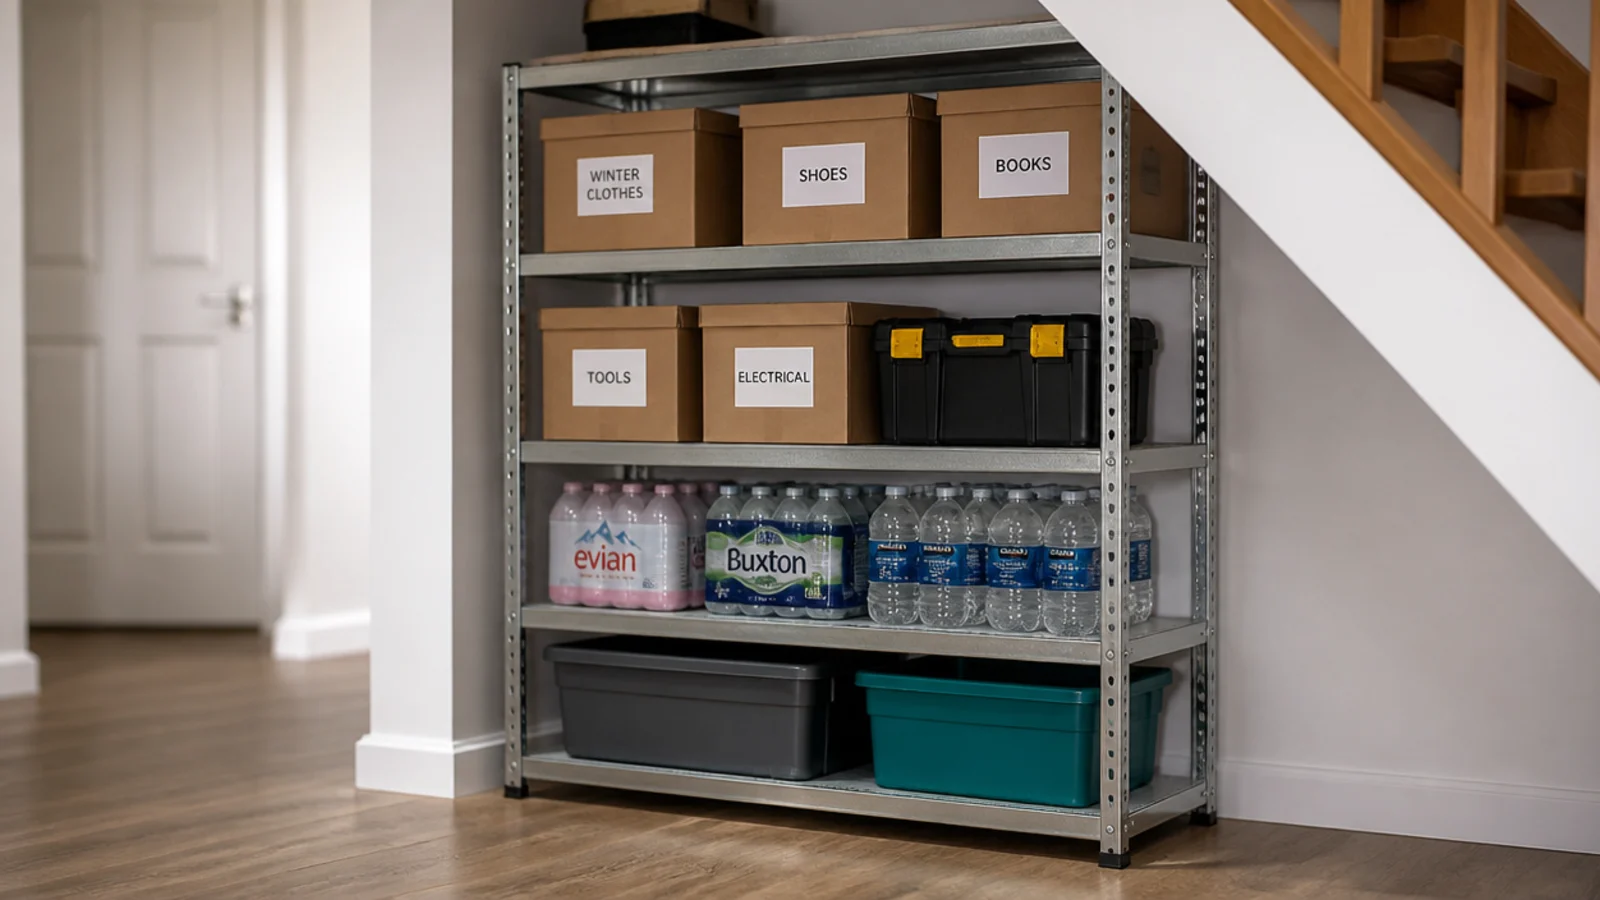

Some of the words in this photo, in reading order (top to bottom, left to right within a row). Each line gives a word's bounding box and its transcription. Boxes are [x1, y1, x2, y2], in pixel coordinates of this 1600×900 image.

[996, 156, 1051, 172] BOOKS
[589, 168, 640, 182] WINTER
[799, 167, 848, 182] SHOES
[586, 186, 644, 200] CLOTHES
[587, 371, 631, 384] TOOLS
[738, 371, 810, 383] ELECTRICAL
[574, 544, 636, 572] evian
[727, 548, 807, 575] Buxton
